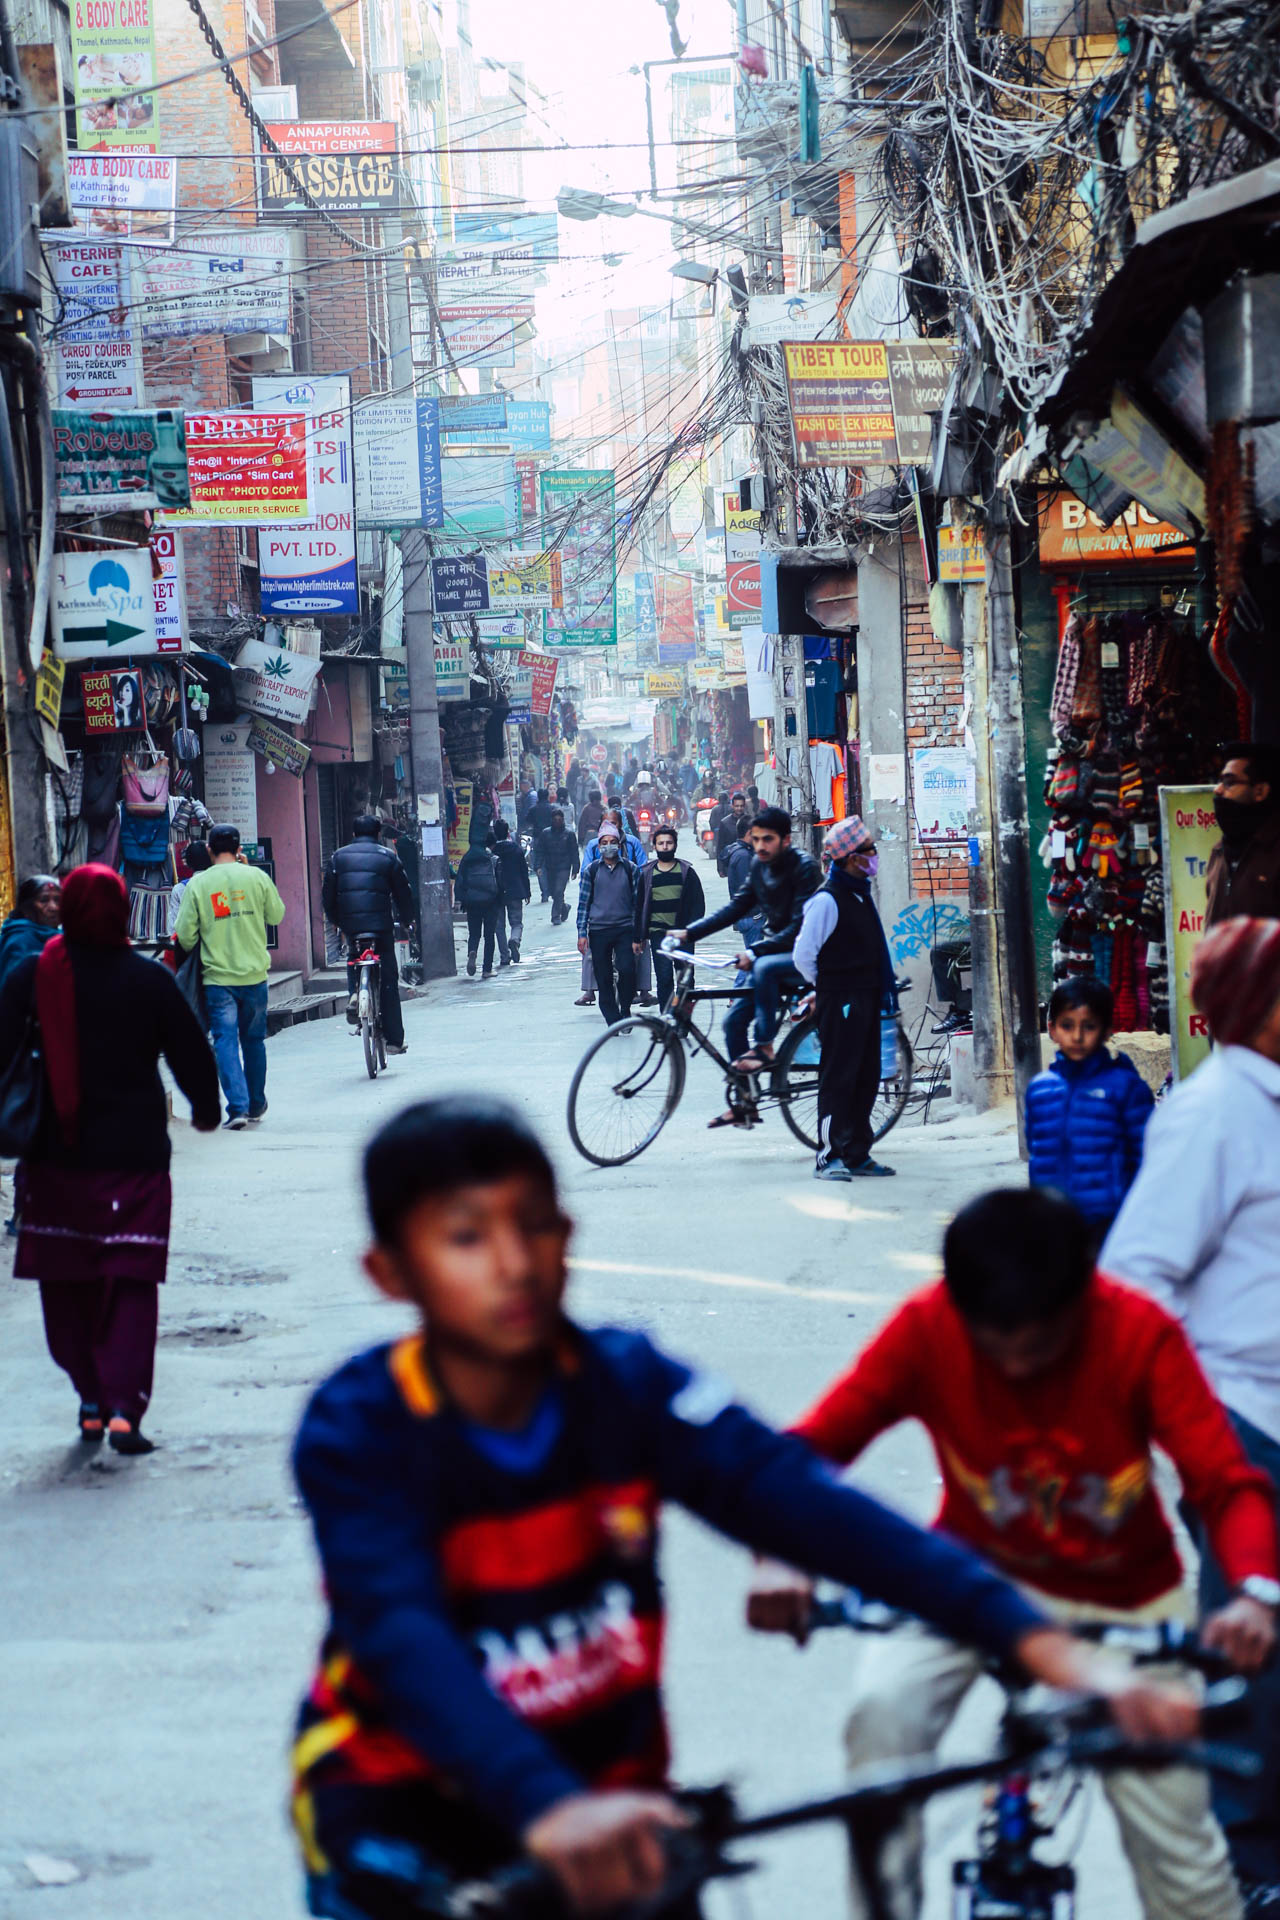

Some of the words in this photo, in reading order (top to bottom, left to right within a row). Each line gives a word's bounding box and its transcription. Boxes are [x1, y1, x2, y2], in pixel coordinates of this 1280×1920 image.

[76, 1, 83, 29] &
[87, 1, 115, 28] BODY
[120, 0, 149, 27] CARE
[287, 126, 370, 137] ANNAPURNA
[277, 140, 325, 151] HEALTH
[330, 139, 383, 149] CENTRE
[90, 158, 98, 176] &
[102, 158, 134, 177] BODY
[138, 160, 170, 179] CARE
[266, 156, 394, 198] MASSAGE
[79, 194, 98, 202] 2nd
[101, 195, 129, 203] Floor
[57, 247, 123, 262] INTERNET
[72, 264, 113, 277] CAFE
[438, 266, 469, 278] NEPAL
[95, 344, 132, 357] COURIER
[789, 347, 835, 367] TIBET
[840, 347, 884, 366] TOUR
[66, 372, 86, 380] POST
[88, 371, 117, 380] PARCEL
[368, 409, 393, 417] LIMITS
[530, 407, 547, 419] Hub
[796, 418, 825, 432] TASHI
[828, 417, 861, 431] DELEK
[862, 416, 894, 430] NEPAL
[53, 427, 154, 453] Robeus
[55, 456, 147, 473] International
[213, 472, 242, 481] Phone
[272, 470, 294, 480] Card
[195, 487, 225, 497] PRINT
[272, 485, 299, 496] COPY
[219, 506, 260, 515] COURIER
[263, 505, 300, 514] SERVICE
[270, 542, 303, 557] PVT.
[308, 542, 343, 557] LTD.
[436, 591, 461, 601] THAMEL
[464, 588, 483, 599] MARG
[106, 592, 144, 617] Spa
[304, 600, 332, 608] Floor
[284, 684, 309, 701] EXPORT
[252, 698, 284, 715] Kathmandu
[268, 734, 284, 748] CARE
[1176, 809, 1195, 827] Our
[1179, 910, 1204, 933] Air
